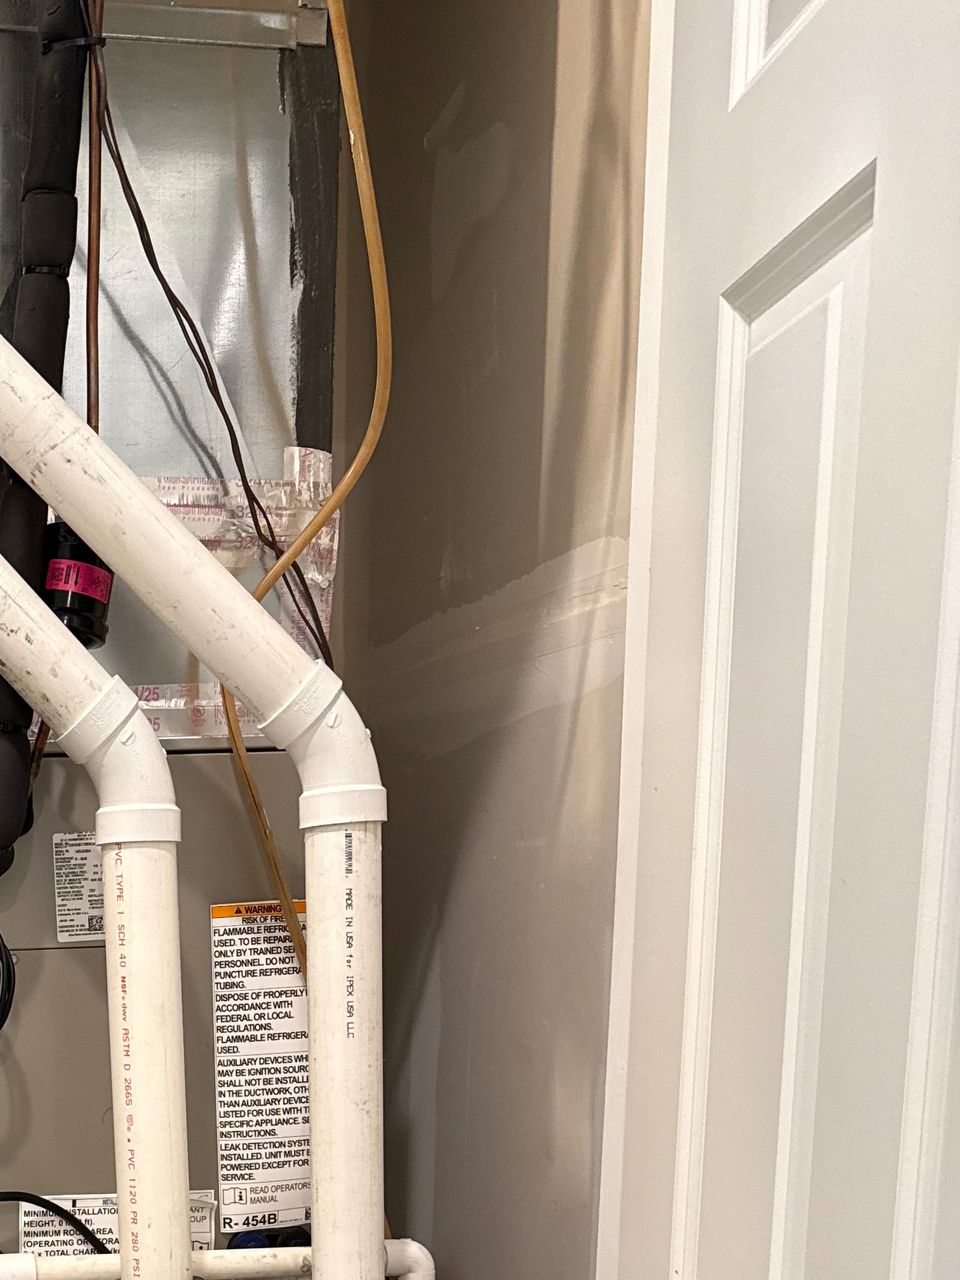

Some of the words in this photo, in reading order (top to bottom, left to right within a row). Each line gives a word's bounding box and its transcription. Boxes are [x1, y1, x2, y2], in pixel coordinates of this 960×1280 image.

[115, 843, 123, 866] PVC
[116, 874, 124, 902] TYPE
[346, 888, 354, 910] MADE
[245, 905, 282, 914] WARNING
[242, 916, 258, 924] RISK
[346, 916, 353, 927] IN
[214, 926, 262, 936] FLAMMABLE
[214, 938, 237, 947] USED.
[239, 938, 250, 946] TO
[251, 937, 262, 945] BE
[346, 931, 354, 949] USA
[214, 950, 235, 958] ONLY
[249, 947, 282, 956] TRAINED
[120, 953, 126, 968] 40
[279, 956, 294, 964] NOT
[215, 969, 258, 979] PUNCTURE
[215, 981, 246, 990] TUBING.
[347, 975, 355, 997] IPEX
[216, 993, 250, 1002] DISPOSE
[263, 989, 304, 999] PROPERLY
[216, 1002, 272, 1012] ACCORDANCE
[273, 1000, 293, 1008] WITH
[347, 1001, 355, 1018] USA
[216, 1014, 252, 1022] FEDERAL
[267, 1011, 294, 1020] LOCAL
[217, 1023, 273, 1033] REGULATIONS.
[347, 1021, 355, 1039] LLC
[122, 1028, 130, 1058] ASTM
[217, 1034, 266, 1044] FLAMMABLE
[217, 1046, 240, 1054] USED.
[217, 1057, 258, 1067] AUXILIARY
[259, 1055, 292, 1065] DEVICES
[123, 1063, 131, 1071] D
[248, 1066, 282, 1076] IGNITION
[218, 1079, 243, 1088] SHALL
[245, 1078, 261, 1086] NOT
[263, 1078, 273, 1086] BE
[124, 1077, 133, 1107] 2665
[219, 1090, 226, 1098] IN
[227, 1089, 242, 1097] THE
[244, 1087, 292, 1096] DUCTWORK,
[219, 1100, 240, 1108] THAN
[241, 1098, 281, 1107] AUXILIARY
[219, 1110, 246, 1118] LISTED
[247, 1109, 264, 1117] FOR
[265, 1108, 281, 1116] USE
[282, 1106, 302, 1115] WITH
[219, 1119, 254, 1128] SPECIFIC
[255, 1117, 300, 1127] APPLIANCE.
[220, 1129, 278, 1138] INSTRUCTIONS.
[220, 1142, 241, 1151] LEAK
[242, 1140, 286, 1150] DETECTION
[221, 1152, 263, 1161] INSTALLED.
[265, 1151, 283, 1159] UNIT
[284, 1149, 306, 1158] MUST
[221, 1162, 260, 1171] POWERED
[261, 1160, 292, 1169] EXCEPT
[293, 1158, 309, 1167] FOR
[221, 1173, 256, 1181] SERVICE.
[129, 1177, 137, 1205] 1120
[250, 1186, 269, 1194] READ
[250, 1195, 278, 1204] MANUAL
[131, 1210, 138, 1225] PR
[242, 1213, 277, 1227] 454B
[24, 1220, 56, 1228] HEIGHT,
[23, 1239, 74, 1248] (OPERATING
[131, 1232, 139, 1253] 280
[132, 1258, 141, 1278] PSI
